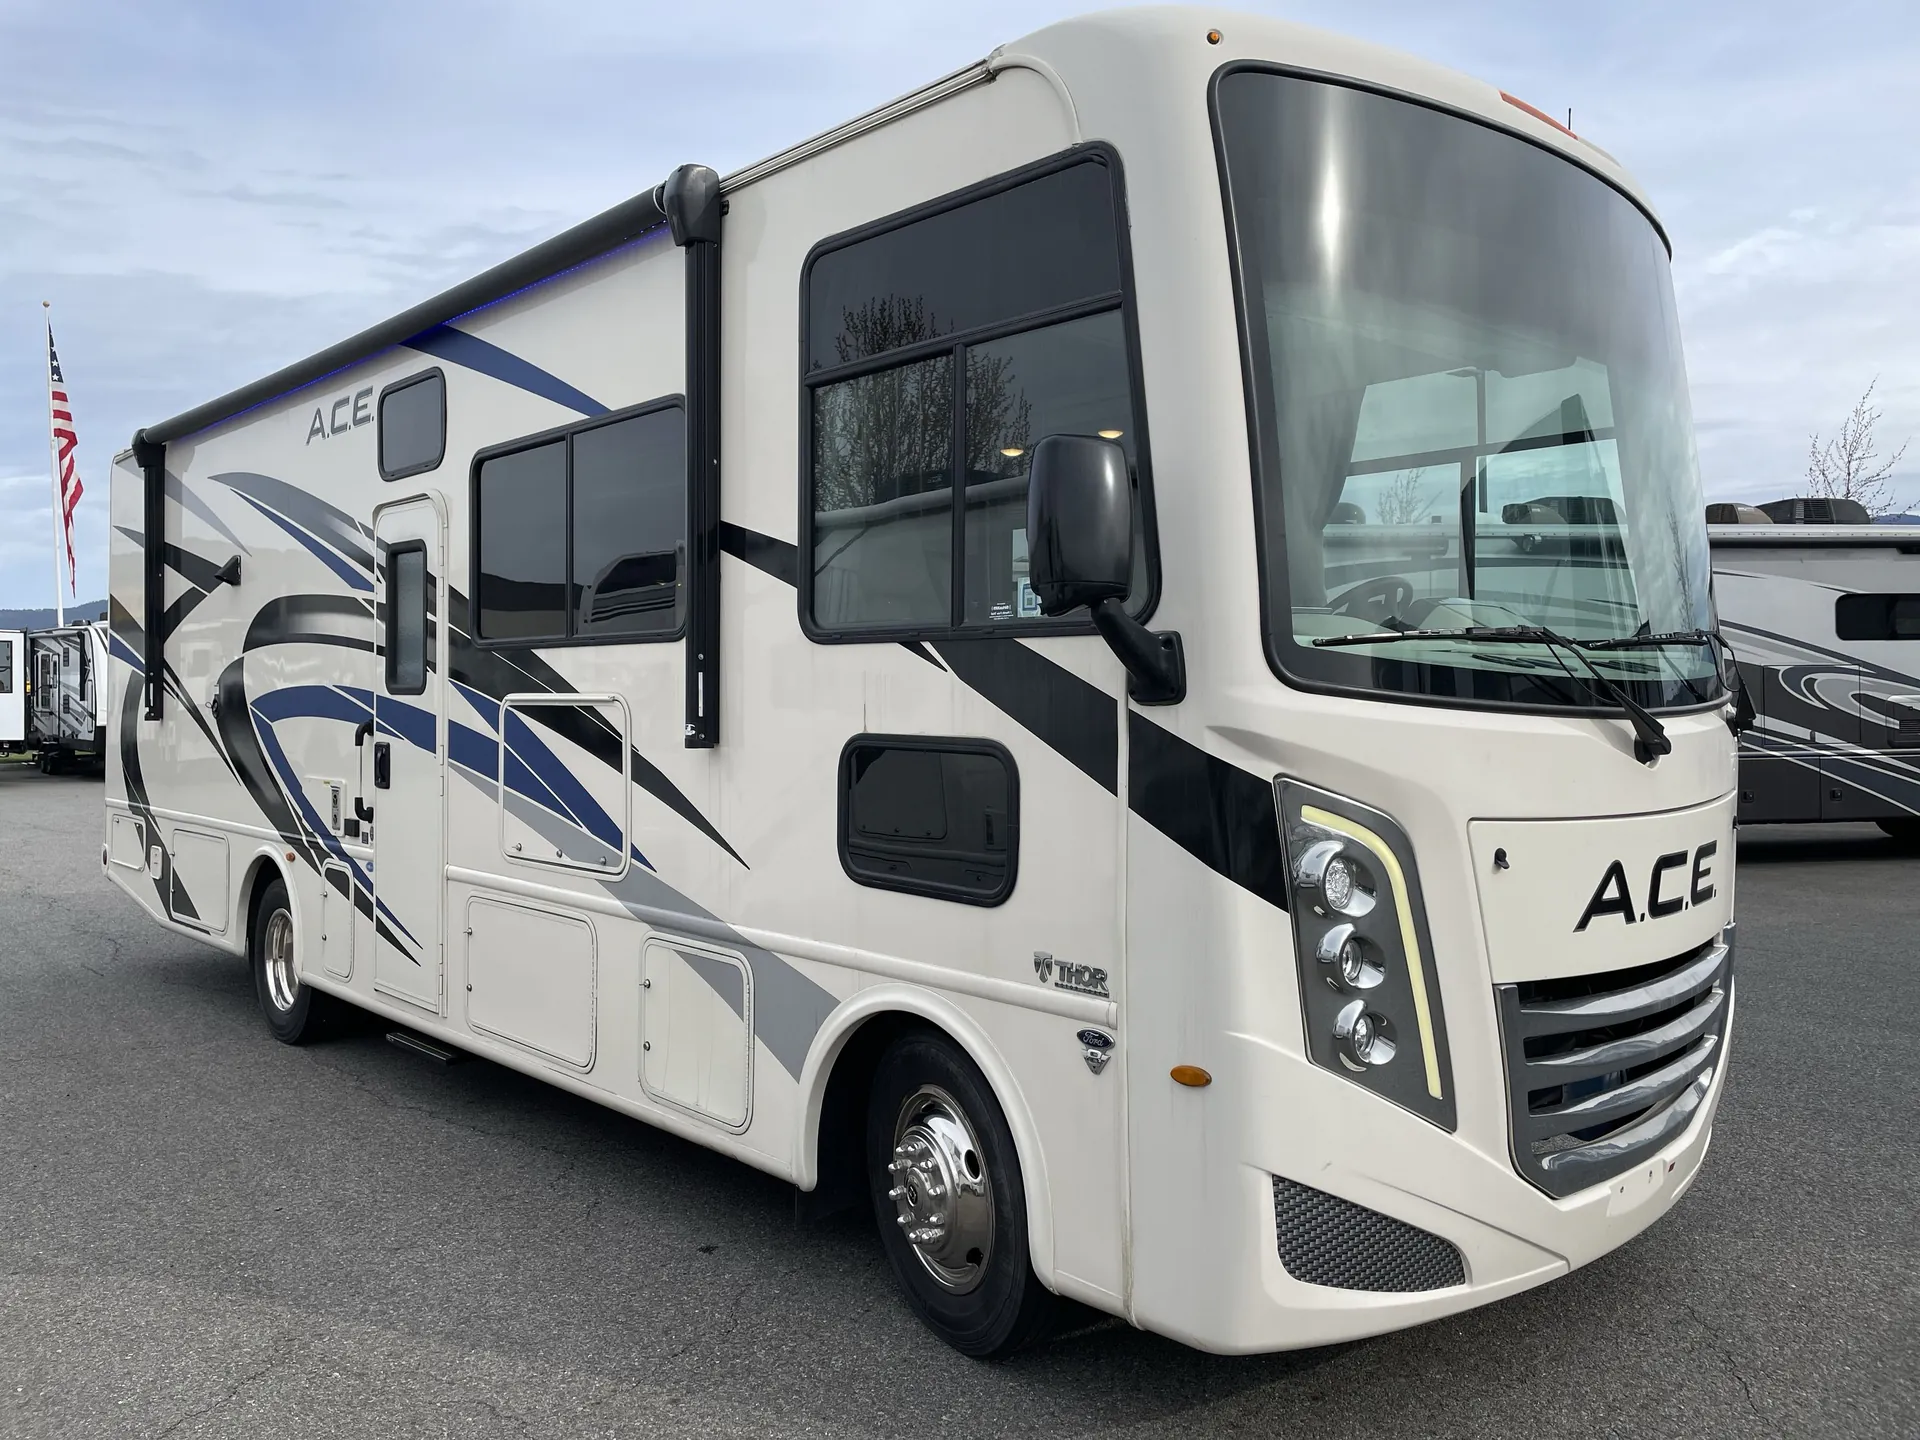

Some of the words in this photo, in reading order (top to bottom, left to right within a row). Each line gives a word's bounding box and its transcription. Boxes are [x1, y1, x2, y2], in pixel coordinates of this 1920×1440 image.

[306, 385, 375, 446] A.C.E.
[1573, 839, 1718, 933] A.C.E.
[1054, 959, 1109, 992] THOR
[1082, 1031, 1105, 1048] Ford
